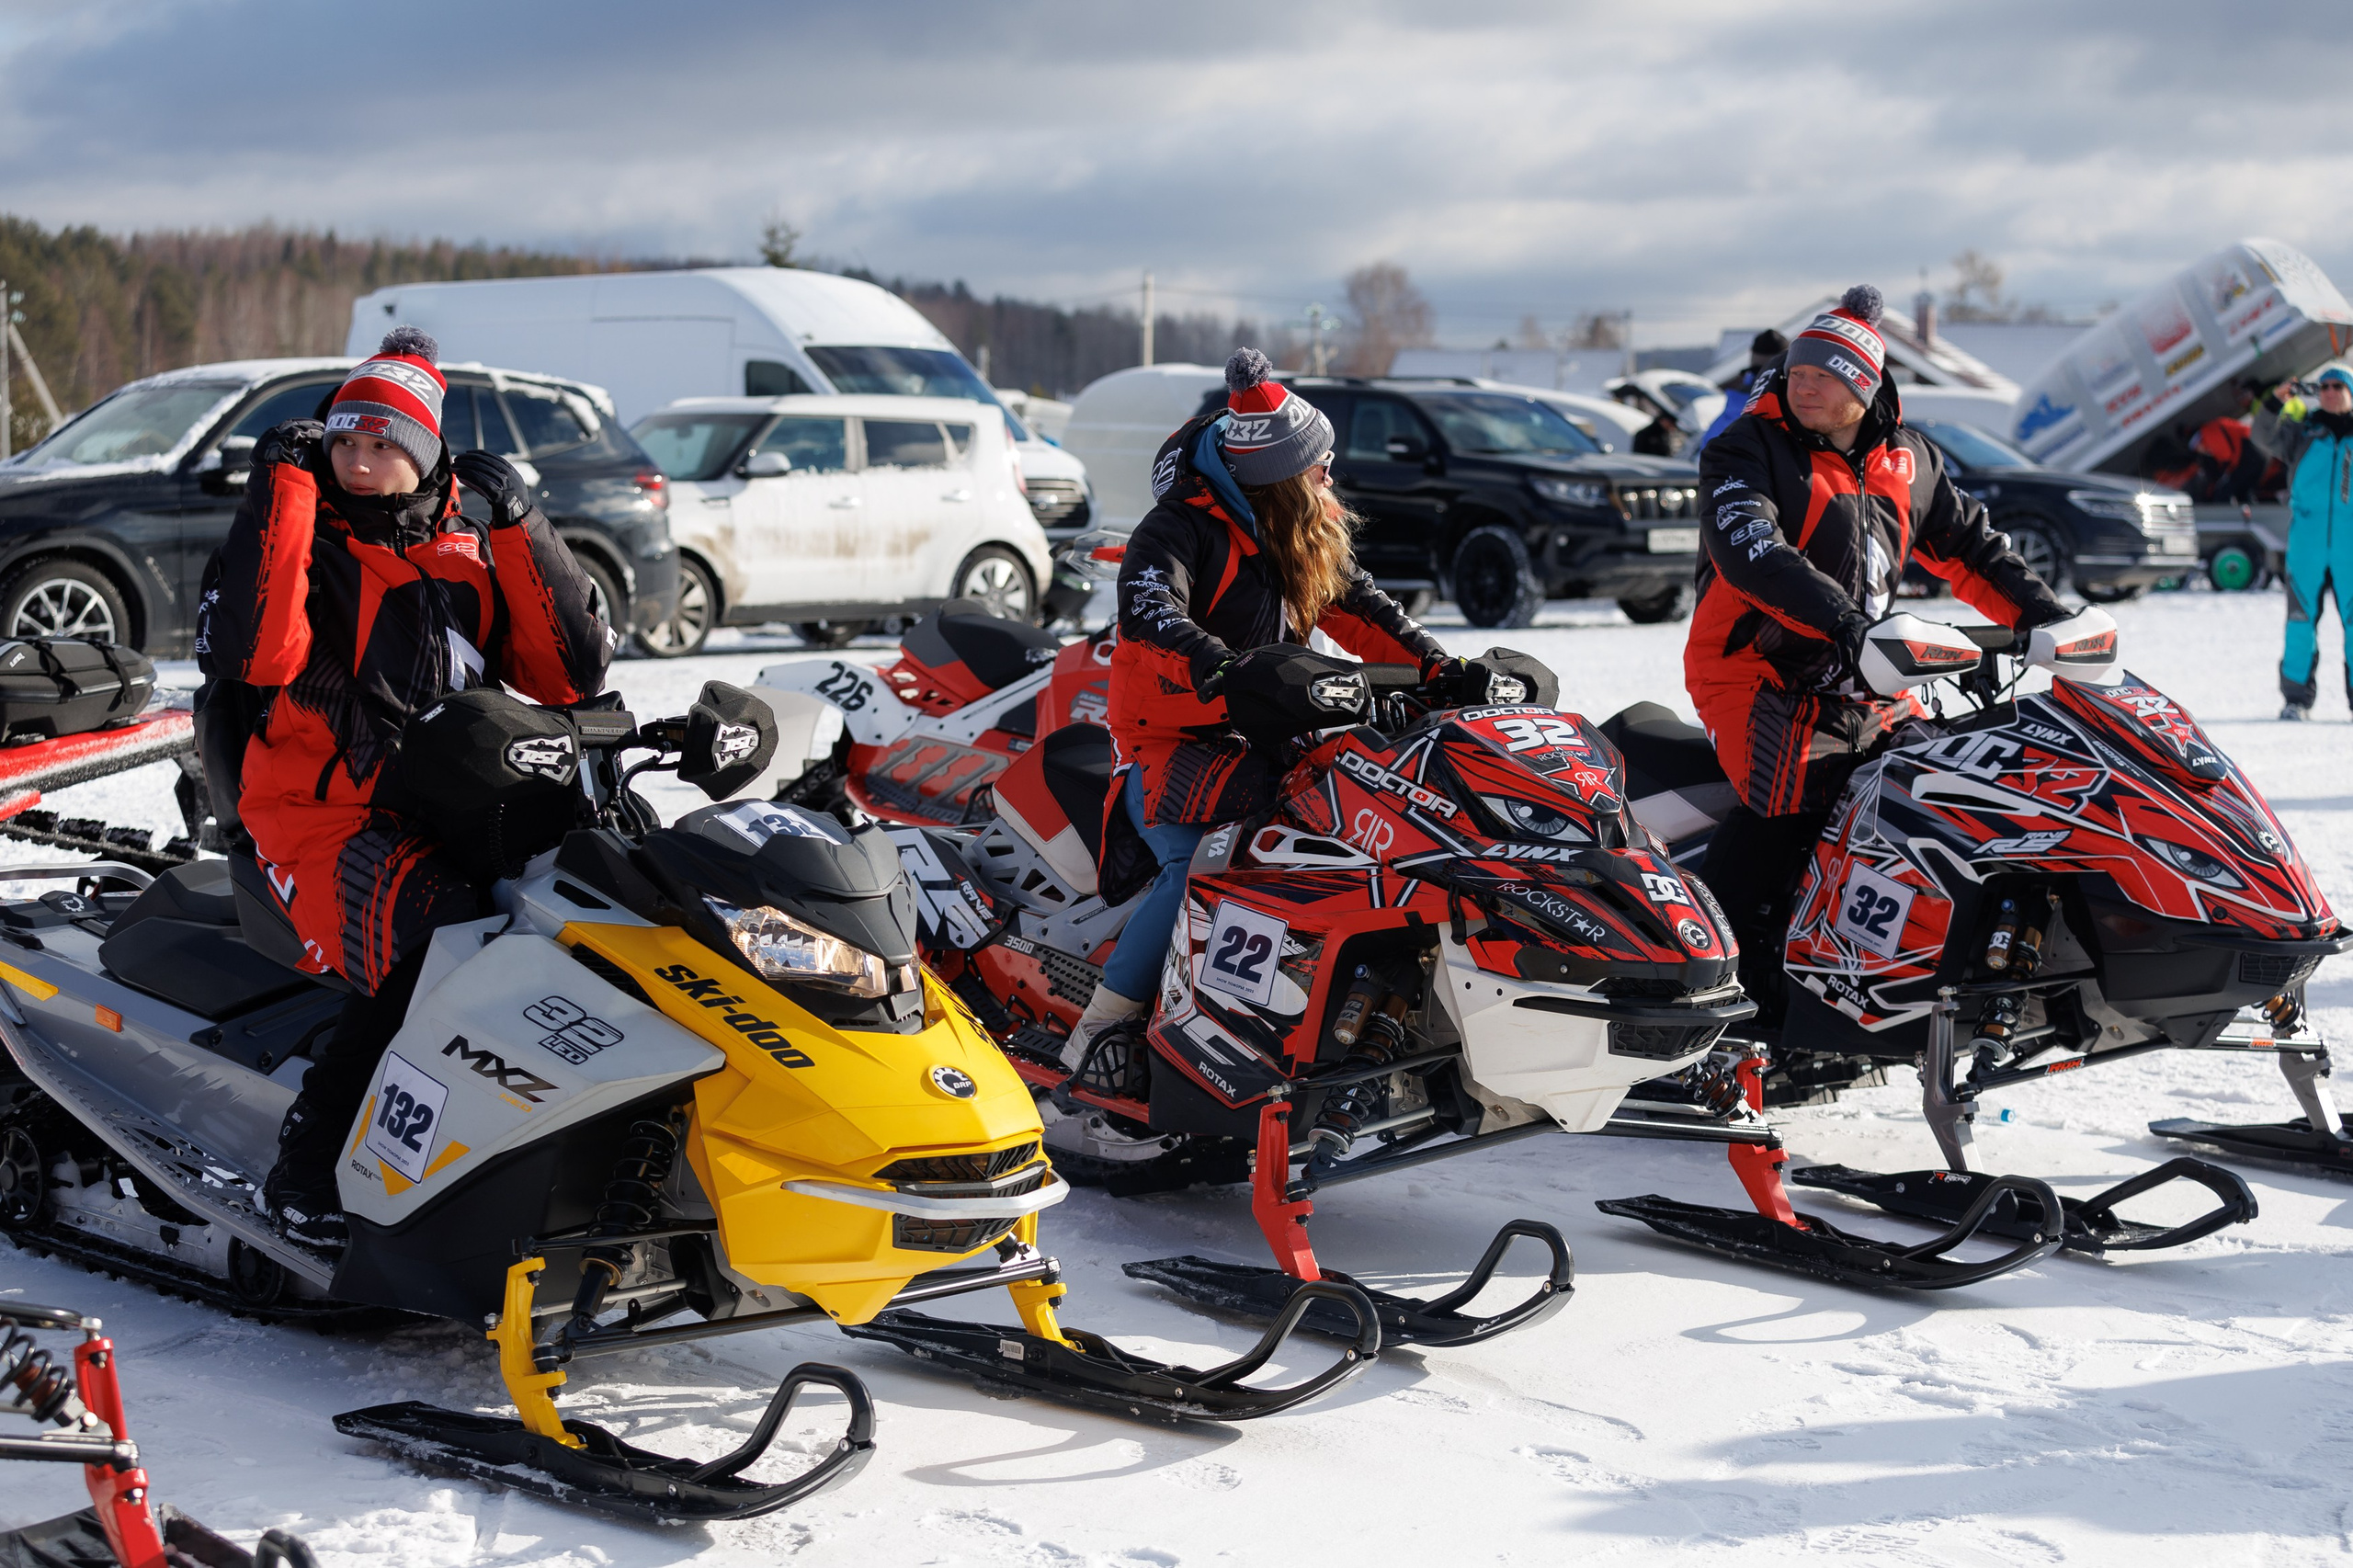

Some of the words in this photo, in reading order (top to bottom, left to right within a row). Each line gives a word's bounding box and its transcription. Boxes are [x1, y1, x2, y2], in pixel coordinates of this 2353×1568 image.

[1726, 499, 1762, 510] brembo
[815, 661, 874, 711] 226
[1462, 707, 1556, 722] DOCTOR
[2120, 695, 2180, 718] 32
[1492, 718, 1586, 753] 32
[2021, 722, 2075, 746] LYNX
[2191, 756, 2219, 767] LYNX
[1339, 750, 1459, 819] DOCTOR
[1972, 836, 2066, 854] RS
[2021, 830, 2071, 840] RAVE
[1480, 843, 1585, 862] LYNX
[960, 880, 995, 920] RAVE
[1640, 872, 1691, 906] DC
[1847, 884, 1901, 940] 32
[1004, 934, 1036, 954] 3500
[1988, 931, 2012, 949] DC
[1211, 925, 1273, 984] 22
[1825, 972, 1870, 1009] ROTAX
[522, 995, 625, 1056] 32
[538, 1034, 589, 1065] LEO
[440, 1034, 561, 1104] MXZ
[1198, 1060, 1237, 1098] ROTAX
[952, 1081, 972, 1089] BRP
[497, 1093, 533, 1113] NEO
[377, 1083, 435, 1154] 132
[350, 1159, 373, 1181] ROTAX
